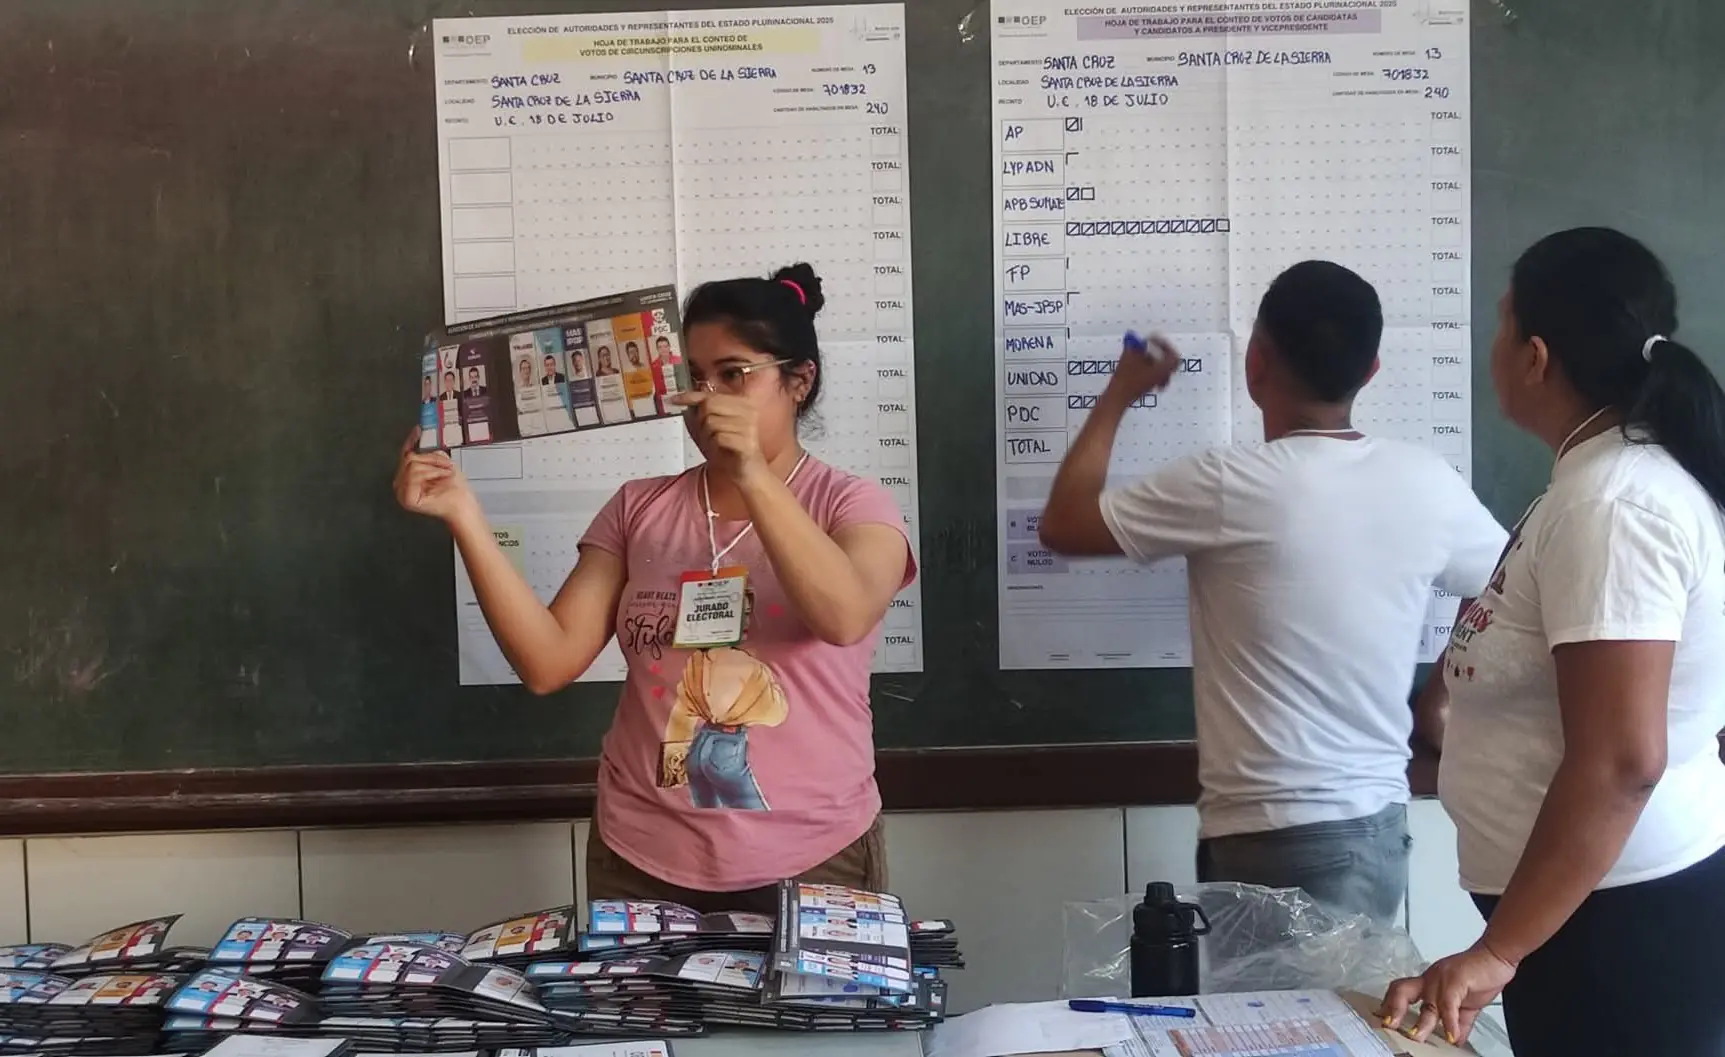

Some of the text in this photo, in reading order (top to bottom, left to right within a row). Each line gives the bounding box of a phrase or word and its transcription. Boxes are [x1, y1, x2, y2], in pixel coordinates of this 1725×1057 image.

[1064, 7, 1104, 16] ELECCIÓN
[1121, 6, 1178, 14] AUTORIDADES
[1188, 2, 1259, 12] REPRESENTANTES
[508, 26, 547, 34] ELECCIÓN
[564, 24, 618, 33] AUTORIDADES
[628, 20, 700, 30] REPRESENTANTES
[752, 18, 814, 26] PLURINACIONAL
[1217, 16, 1250, 24] CONTEO
[1203, 25, 1252, 33] PRESIDENTE
[1262, 23, 1328, 32] VICEPRESIDENTE
[622, 45, 702, 55] CIRCUNSCRIPCIONES
[1426, 48, 1441, 60] 13
[1044, 56, 1115, 71] SANTA CRUZ
[1177, 52, 1220, 67] SANTA
[1224, 51, 1251, 65] CRUZ
[1256, 51, 1272, 64] DE
[623, 66, 777, 84] SANTA CRUZ DE LA SIERRA
[862, 64, 876, 75] 13
[1382, 68, 1429, 80] 701832
[492, 73, 561, 88] SANTA CRUZ
[1041, 76, 1074, 90] SANTA
[1077, 76, 1102, 88] CRUZ
[1105, 77, 1118, 88] DE
[822, 84, 866, 96] 701832
[1425, 87, 1449, 99] 240
[492, 90, 641, 108] SANTA CRUZ DE LA SIERRA
[1084, 96, 1098, 107] 18
[1104, 95, 1120, 106] DE
[1125, 93, 1168, 106] JULIO
[866, 102, 888, 115] 240
[548, 114, 567, 125] DE
[572, 111, 614, 124] JULIO
[1005, 126, 1024, 141] AP
[1004, 199, 1027, 211] APB
[1005, 233, 1050, 247] LIBRE
[1006, 265, 1030, 283] FP
[1006, 336, 1054, 352] MORENA
[1008, 372, 1058, 386] UNIDAD
[1008, 405, 1039, 422] PDC
[1008, 438, 1050, 455] TOTAL
[694, 602, 729, 613] JURADO
[686, 610, 734, 622] ELECTORAL
